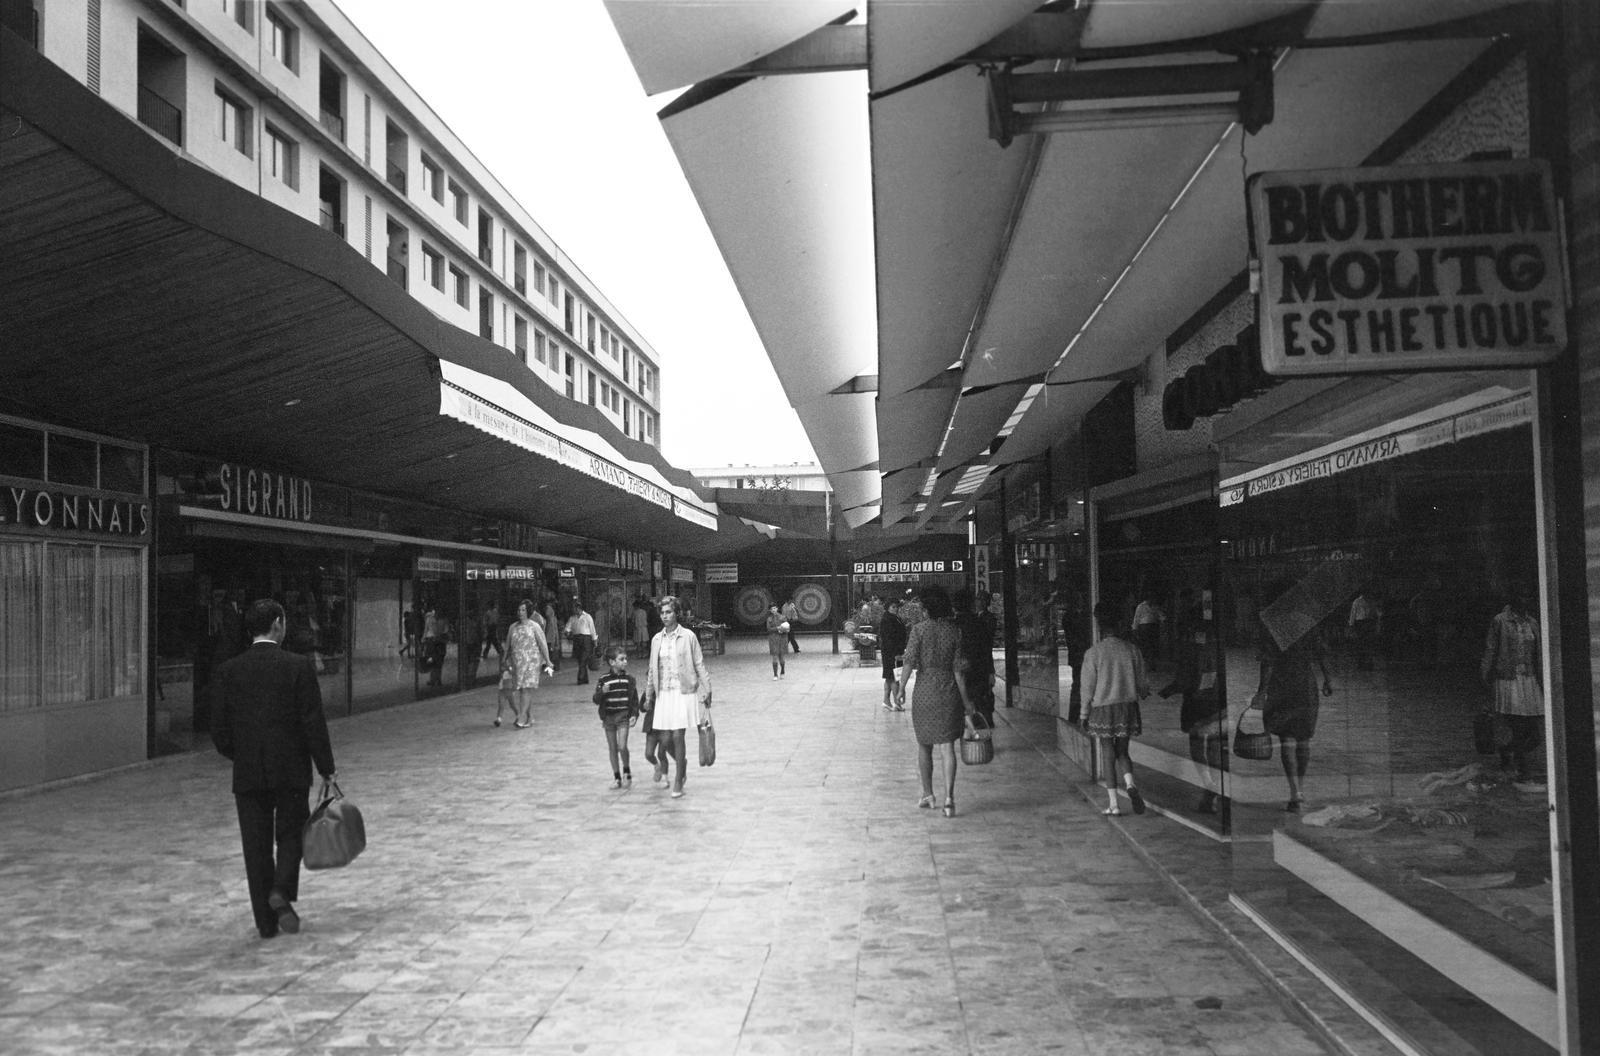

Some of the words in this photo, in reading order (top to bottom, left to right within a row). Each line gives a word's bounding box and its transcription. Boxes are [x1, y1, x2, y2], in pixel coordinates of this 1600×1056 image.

[1263, 173, 1553, 245] BIOTHERM
[1282, 300, 1556, 357] ESTHETIQUE
[219, 463, 313, 521] SIGRAND
[590, 457, 625, 486] ARMAND
[855, 561, 944, 573] PRISUNIC
